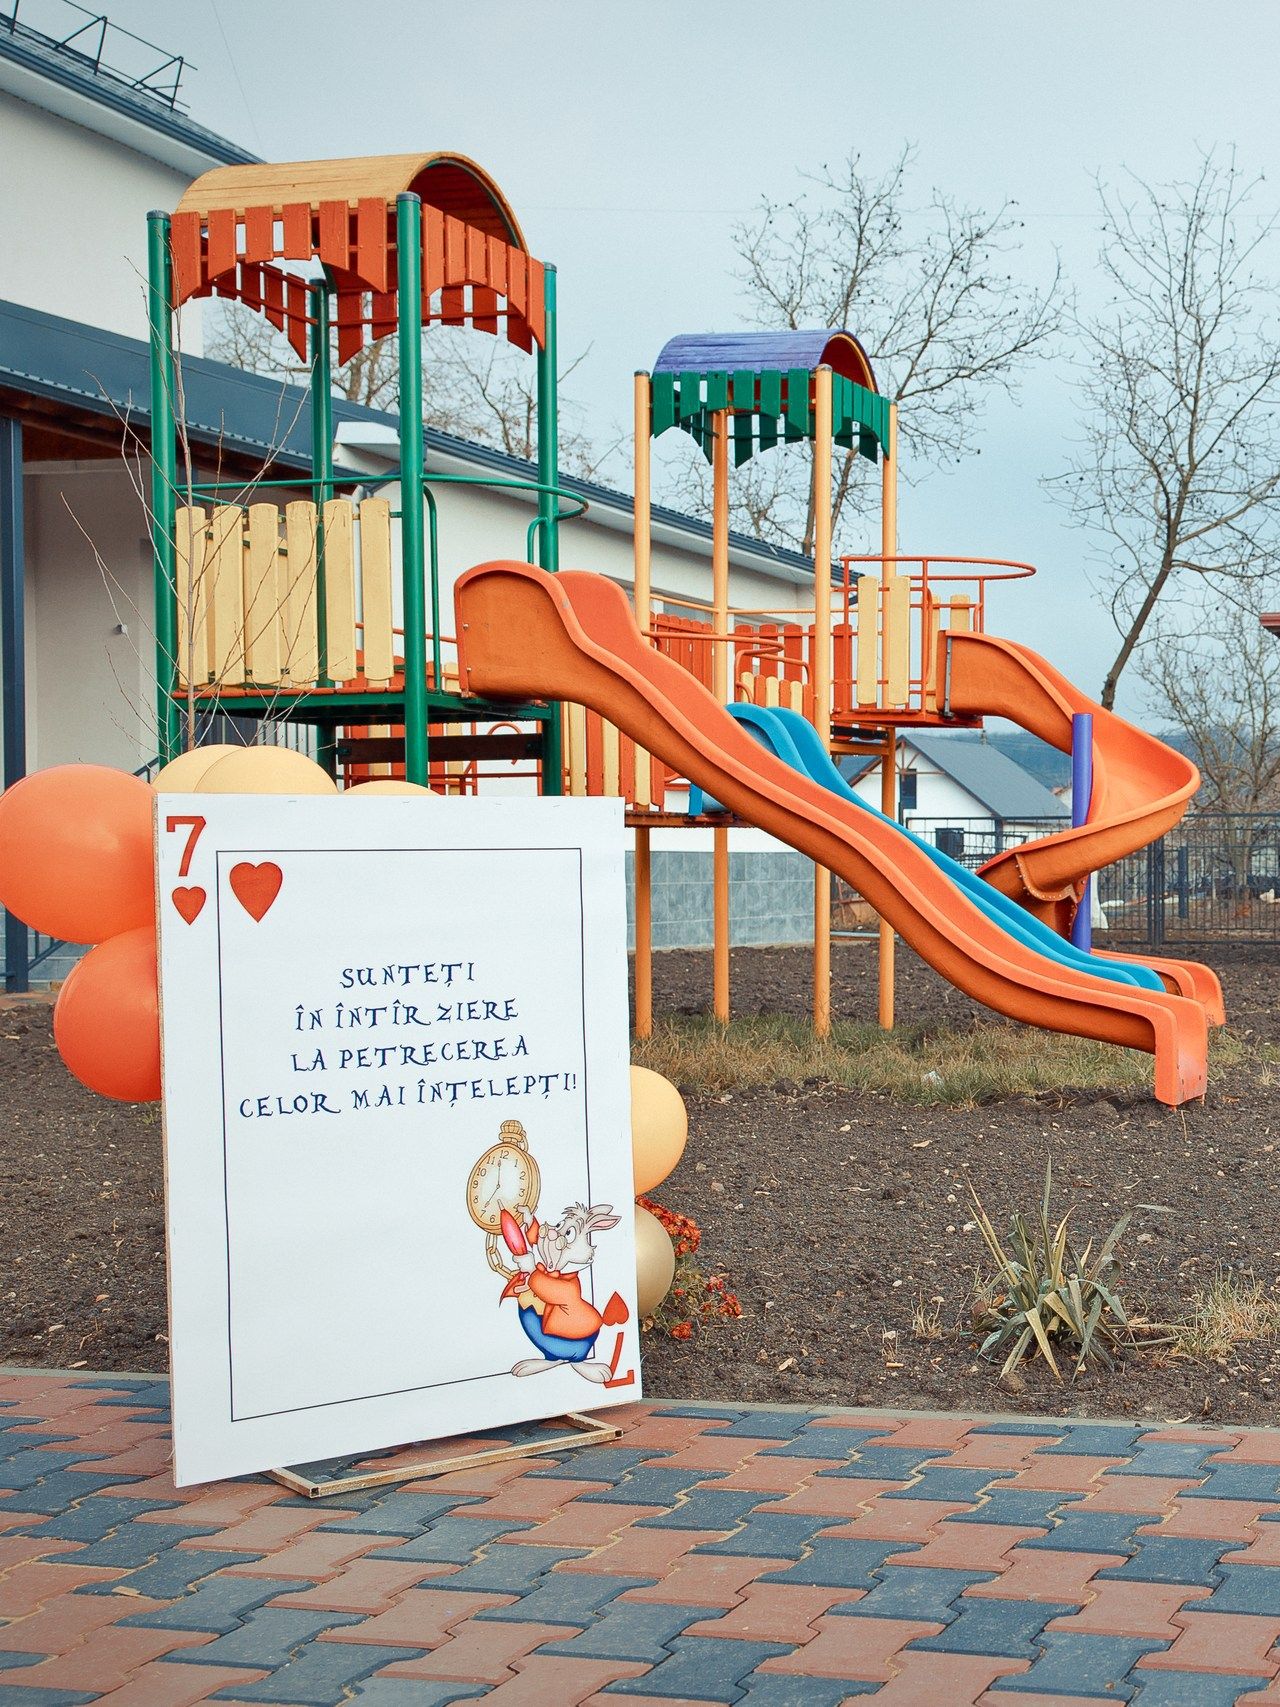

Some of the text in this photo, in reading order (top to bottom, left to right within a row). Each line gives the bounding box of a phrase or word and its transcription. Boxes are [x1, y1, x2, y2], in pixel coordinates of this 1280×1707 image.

[166, 815, 207, 877] 7
[340, 962, 475, 988] SUNTEȚI
[295, 1004, 324, 1031] ÎN
[291, 1035, 529, 1072] LA PETRECEREA
[239, 1073, 577, 1118] CELOR MAI ÎNȚELEPȚI!
[500, 1150, 510, 1159] 12
[487, 1156, 496, 1165] 11
[477, 1168, 487, 1177] 10
[519, 1171, 526, 1180] 2
[473, 1180, 479, 1189] 9
[519, 1188, 526, 1197] 3
[480, 1209, 486, 1218] 7
[489, 1214, 496, 1223] 6
[603, 1331, 635, 1389] 7
